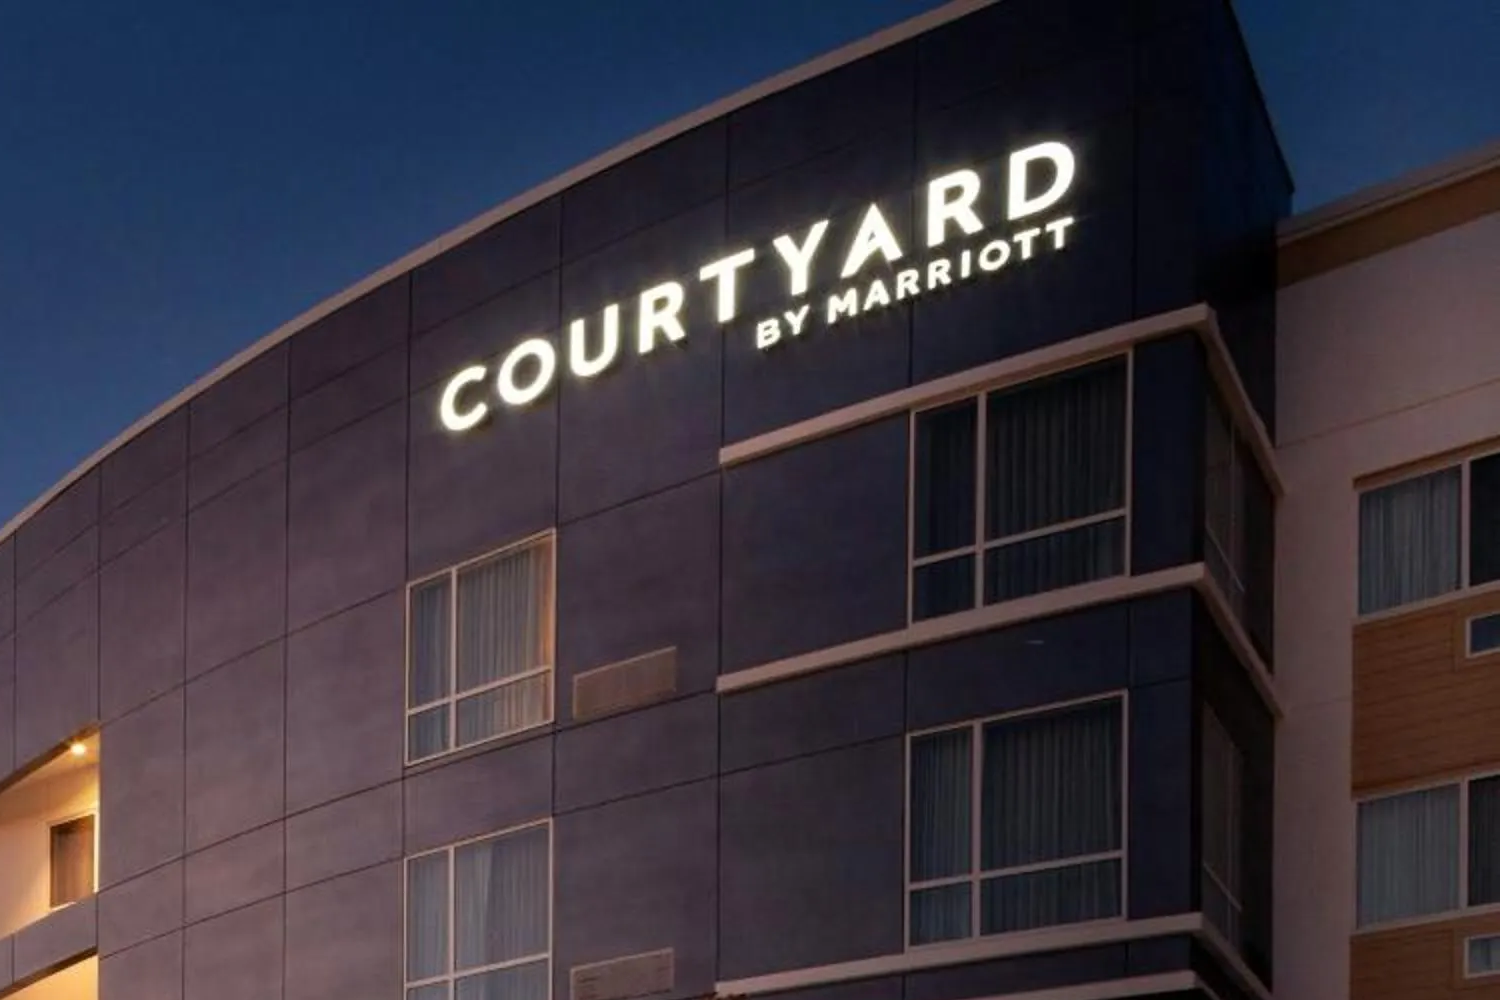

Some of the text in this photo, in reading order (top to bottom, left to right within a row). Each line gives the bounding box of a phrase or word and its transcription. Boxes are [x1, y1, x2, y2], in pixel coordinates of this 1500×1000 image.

[440, 140, 1076, 432] COURTYARD
[756, 216, 1076, 350] BY MARRIOTT
